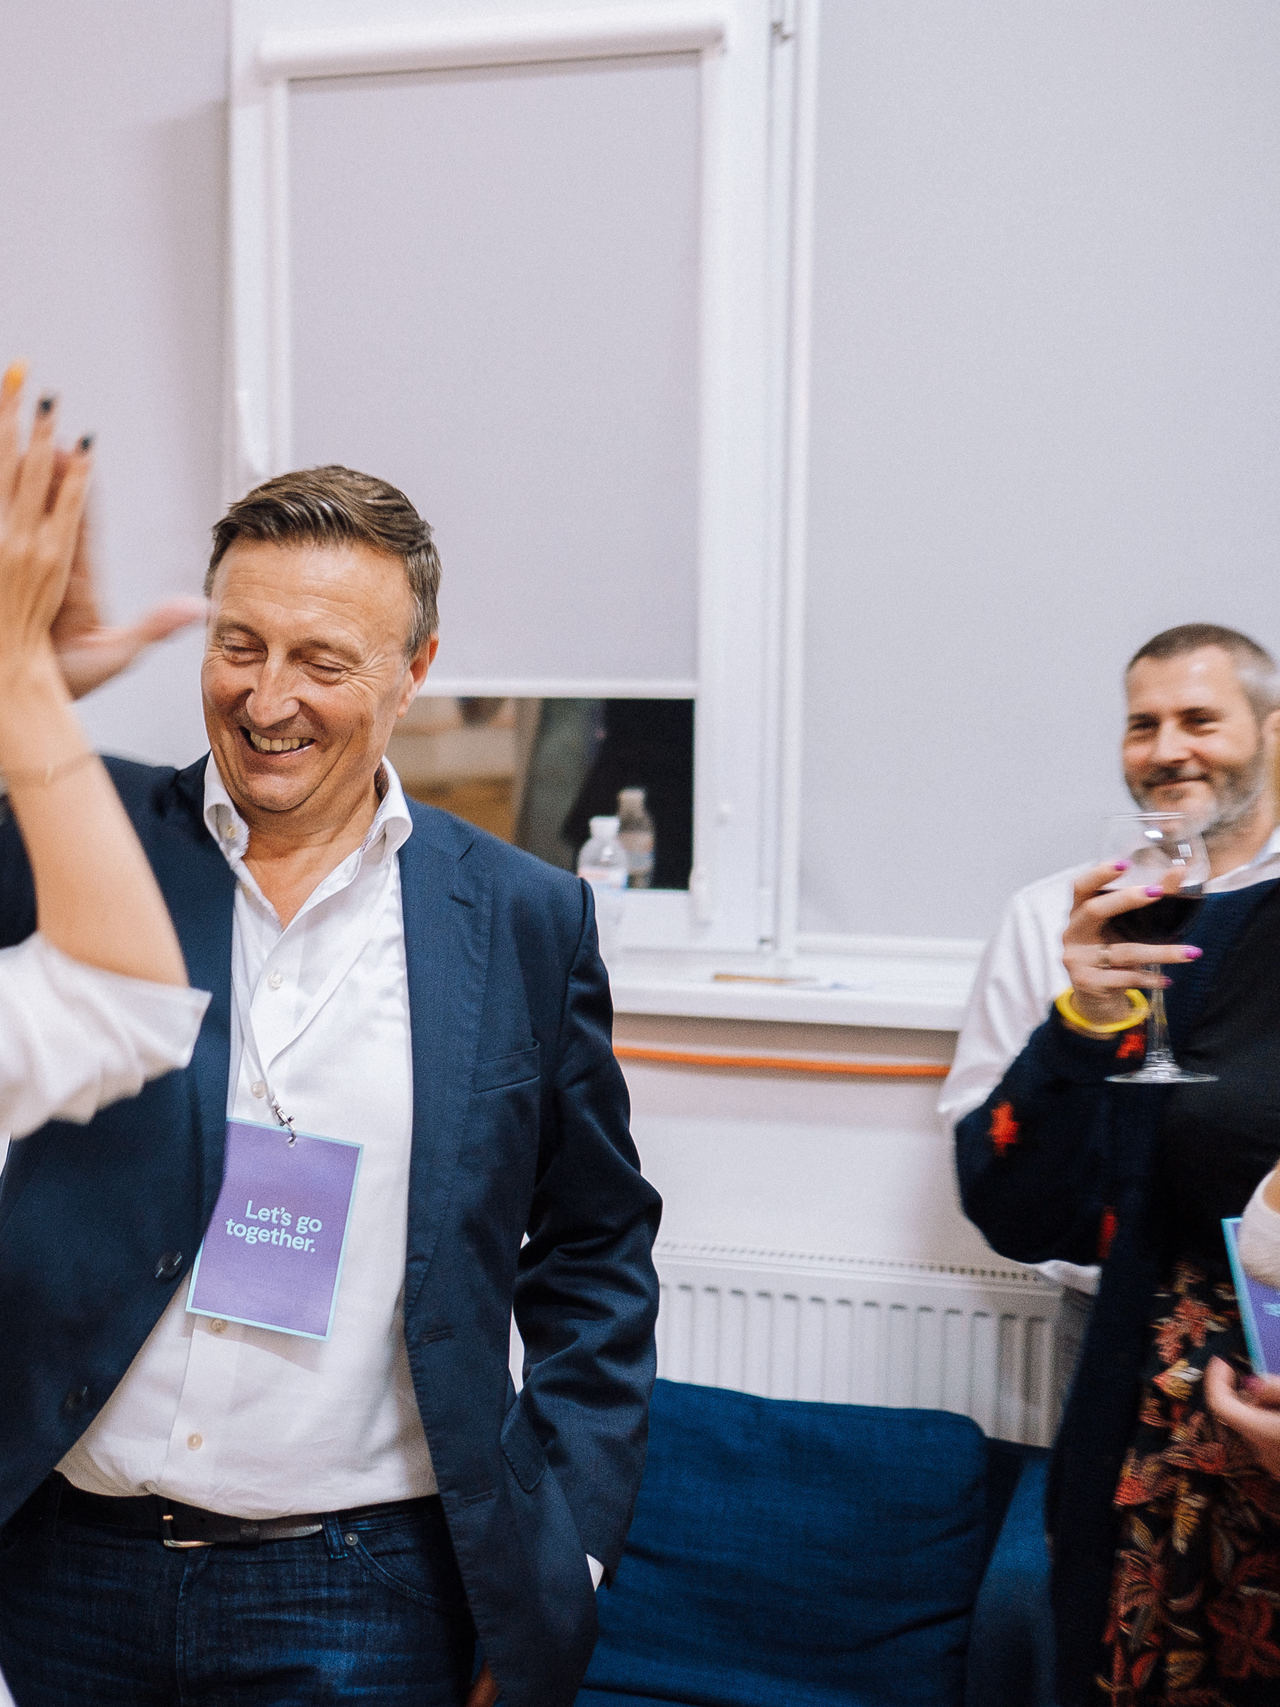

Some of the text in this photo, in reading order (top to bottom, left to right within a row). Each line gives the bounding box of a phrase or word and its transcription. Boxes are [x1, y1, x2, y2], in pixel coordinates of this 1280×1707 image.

[245, 1200, 322, 1235] Let's go
[226, 1218, 316, 1252] together.
